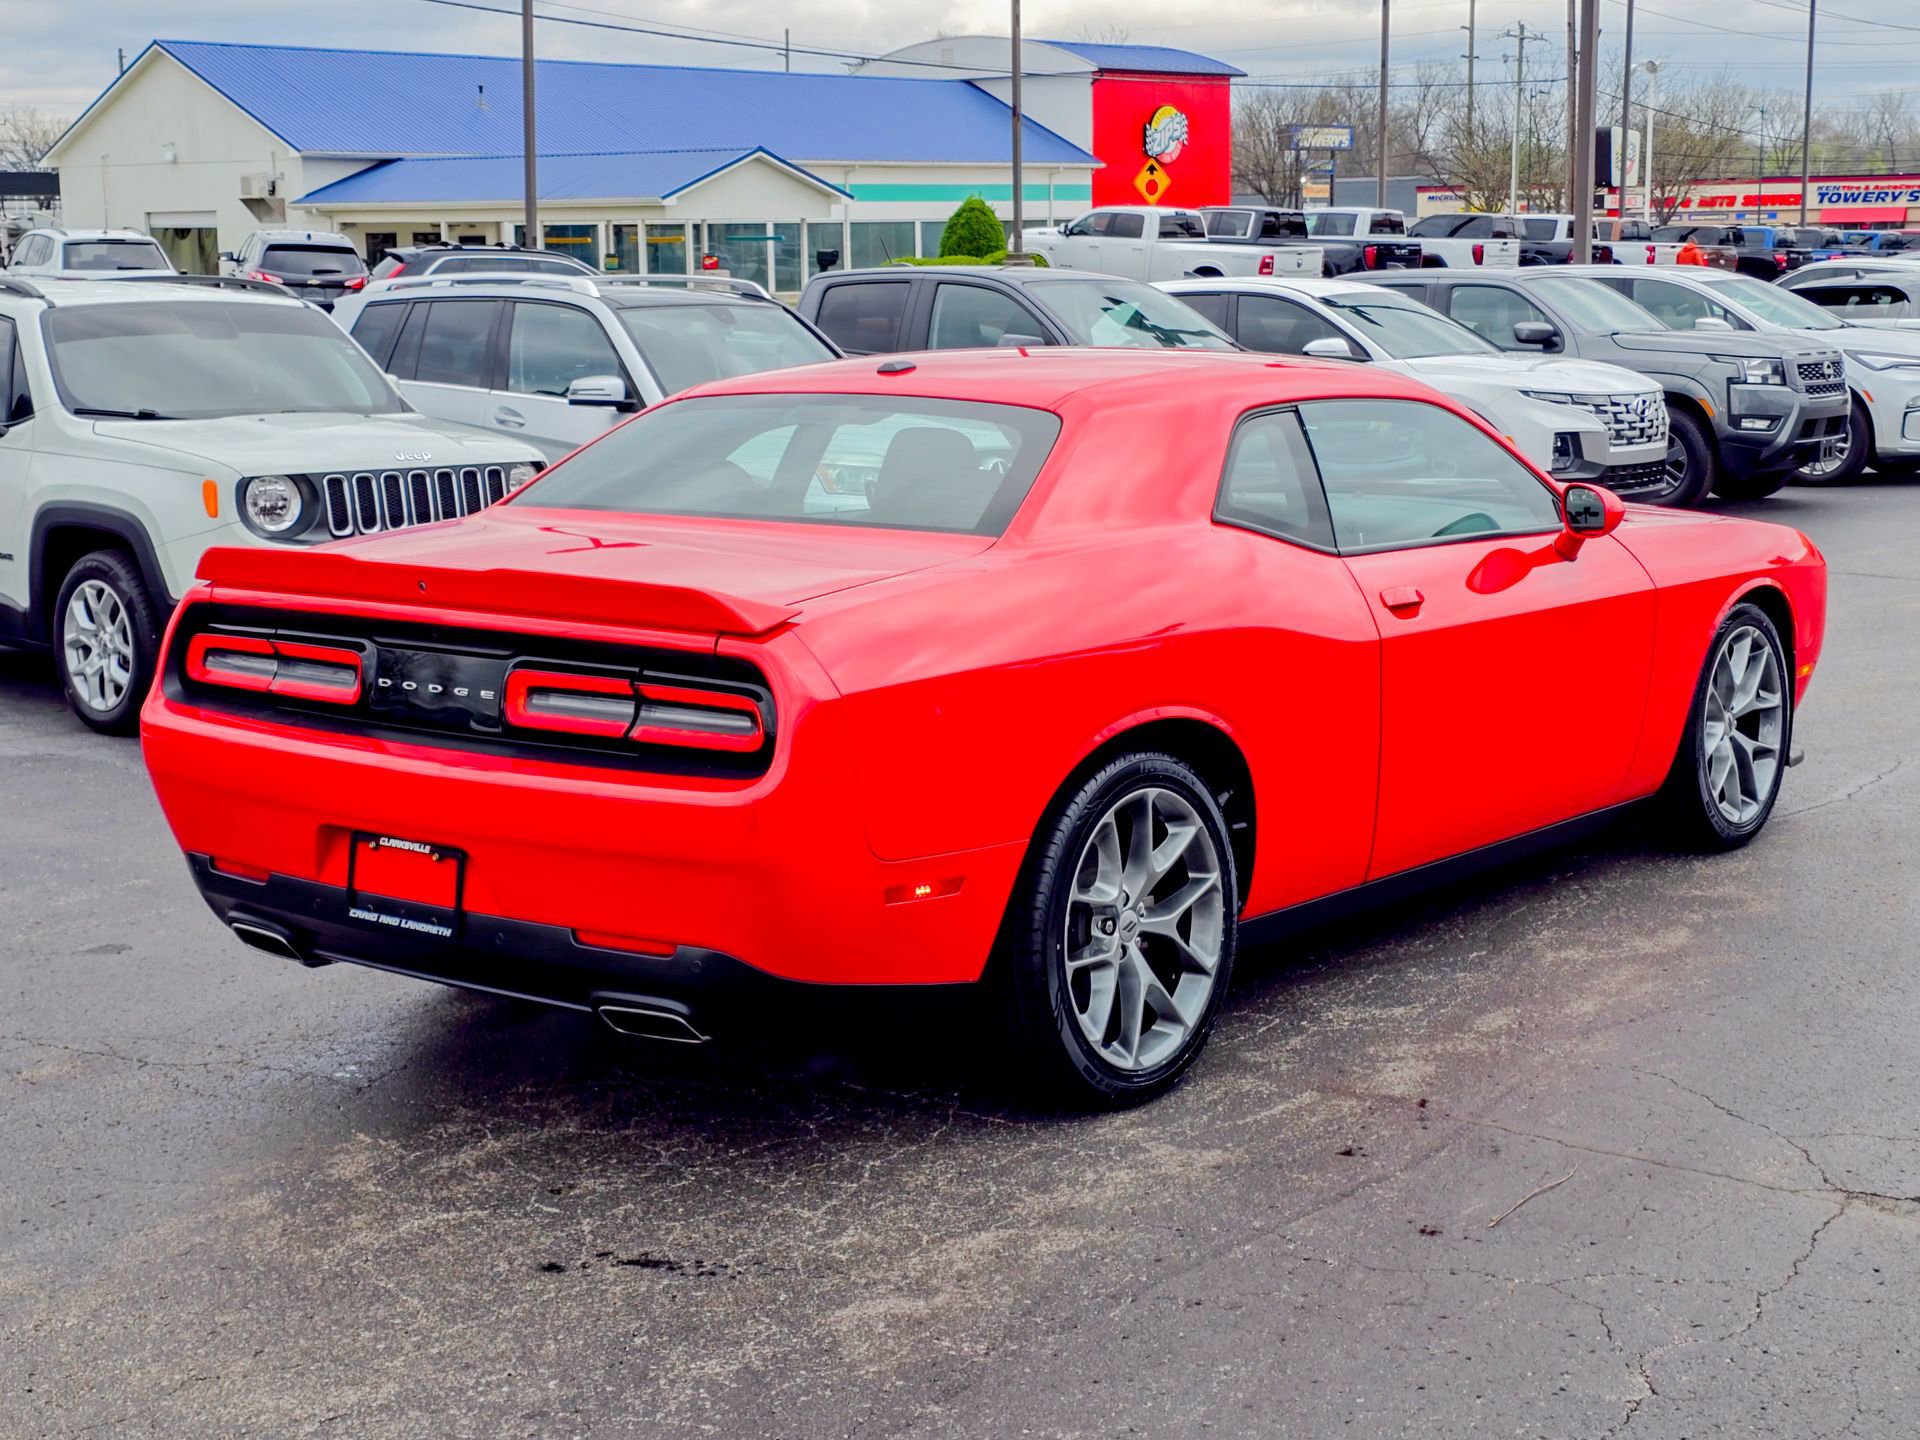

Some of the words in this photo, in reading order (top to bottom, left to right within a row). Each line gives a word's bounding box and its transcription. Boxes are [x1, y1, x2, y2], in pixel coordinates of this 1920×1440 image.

[1152, 115, 1183, 153] ZIPS
[1817, 190, 1920, 204] TOWERY'S
[395, 450, 432, 462] Jeep
[378, 678, 495, 700] DODGE
[379, 837, 431, 854] CLARKSVILLE
[348, 909, 379, 922] CRAIG
[379, 914, 399, 926] AND
[400, 919, 452, 937] LANDRETH
